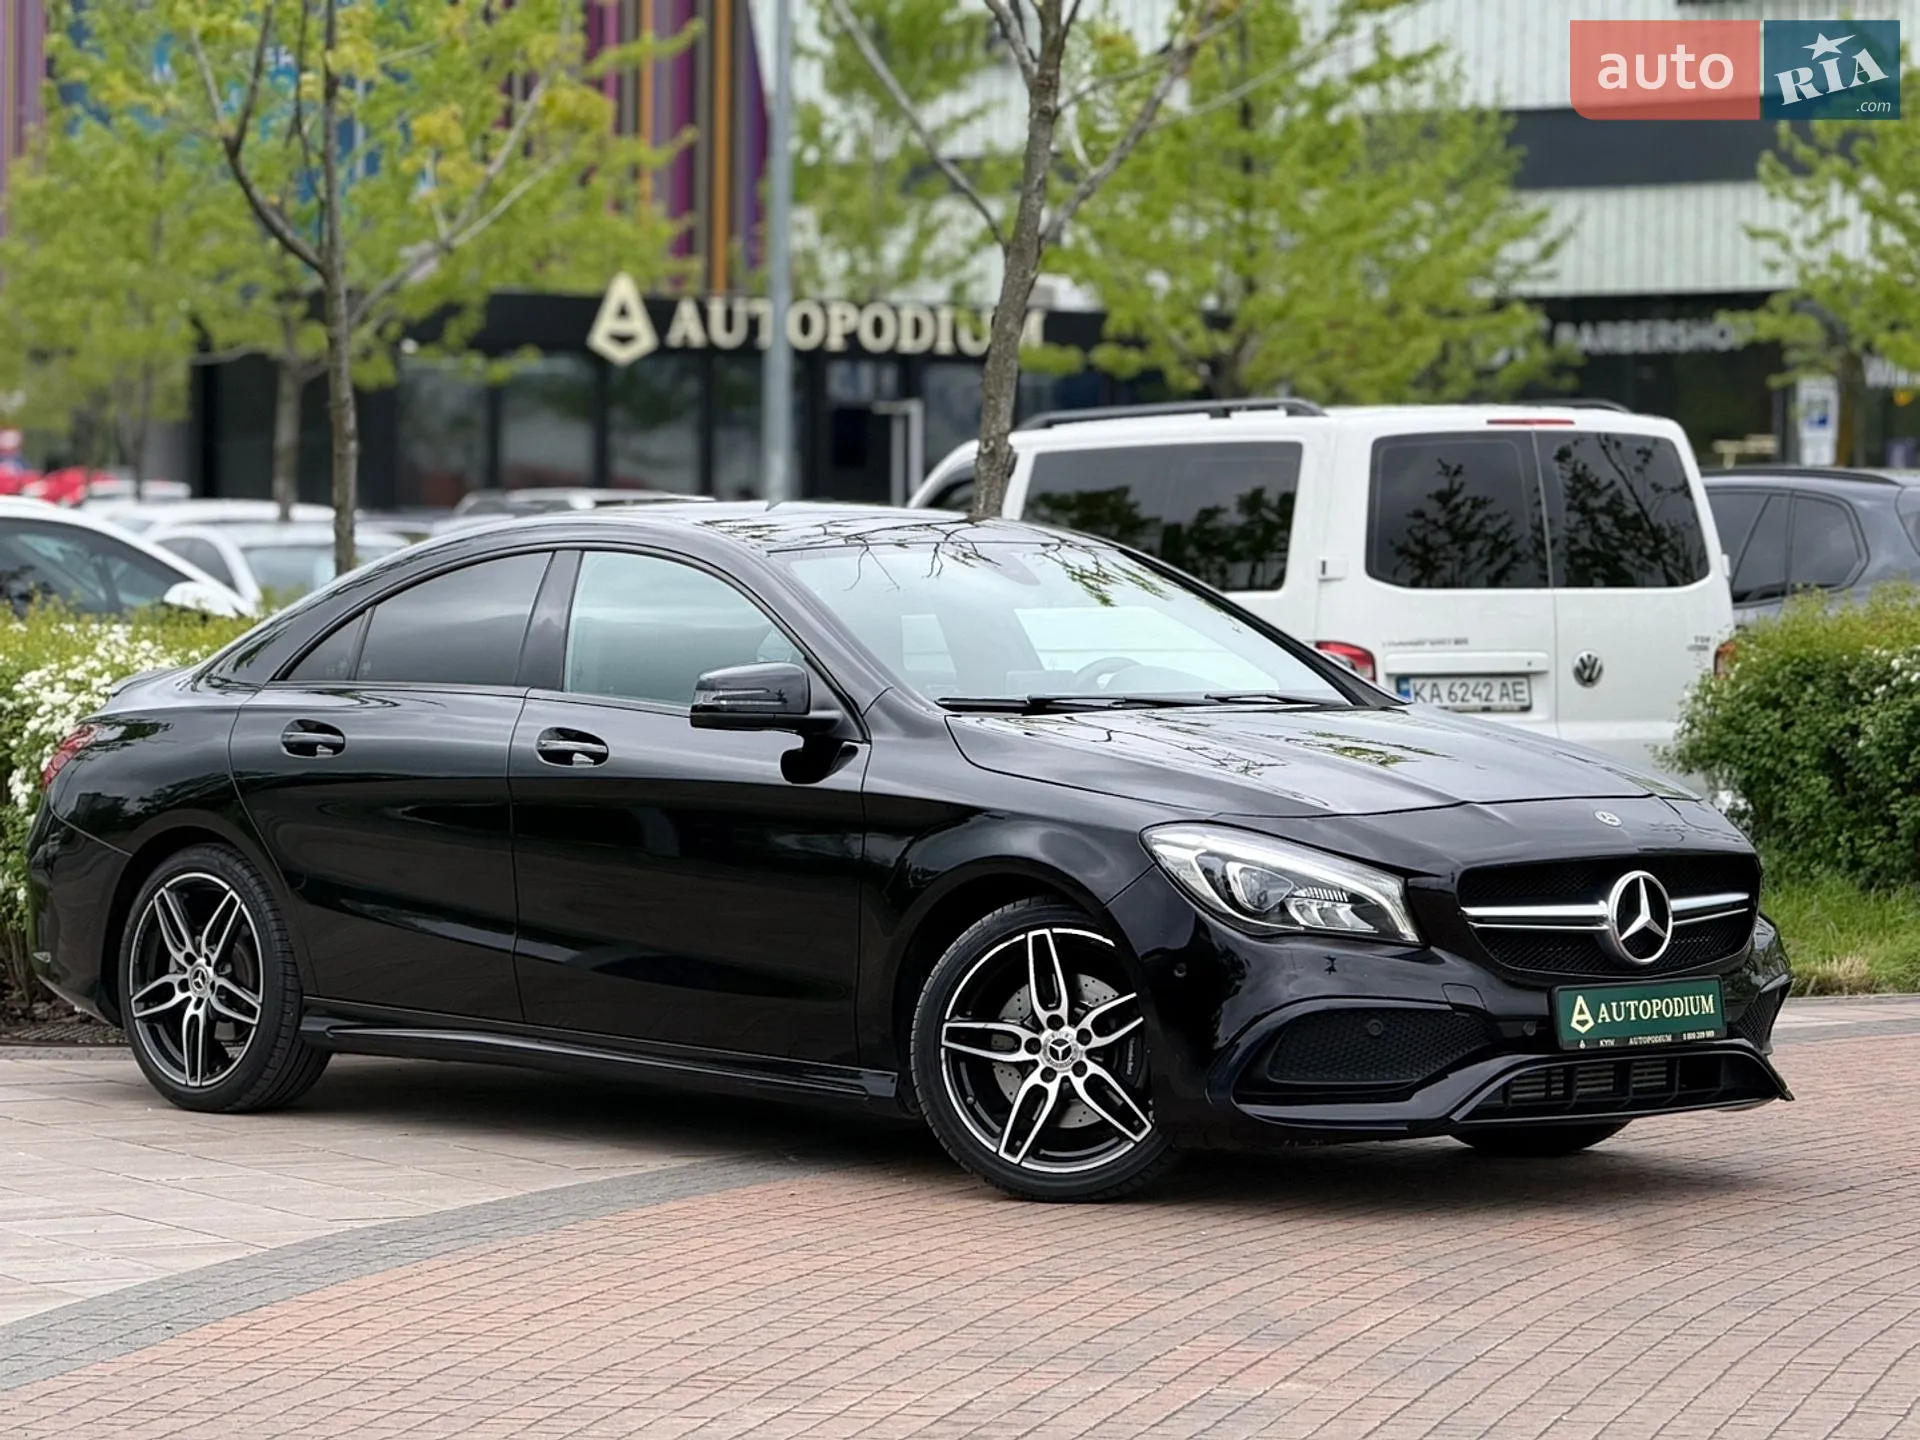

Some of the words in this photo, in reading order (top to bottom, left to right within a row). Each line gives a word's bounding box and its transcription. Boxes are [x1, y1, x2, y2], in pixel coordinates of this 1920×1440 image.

[1412, 681, 1442, 703] KA
[1447, 681, 1494, 703] 6242
[1499, 681, 1527, 703] AE
[1597, 994, 1715, 1024] AUTOPODIUM
